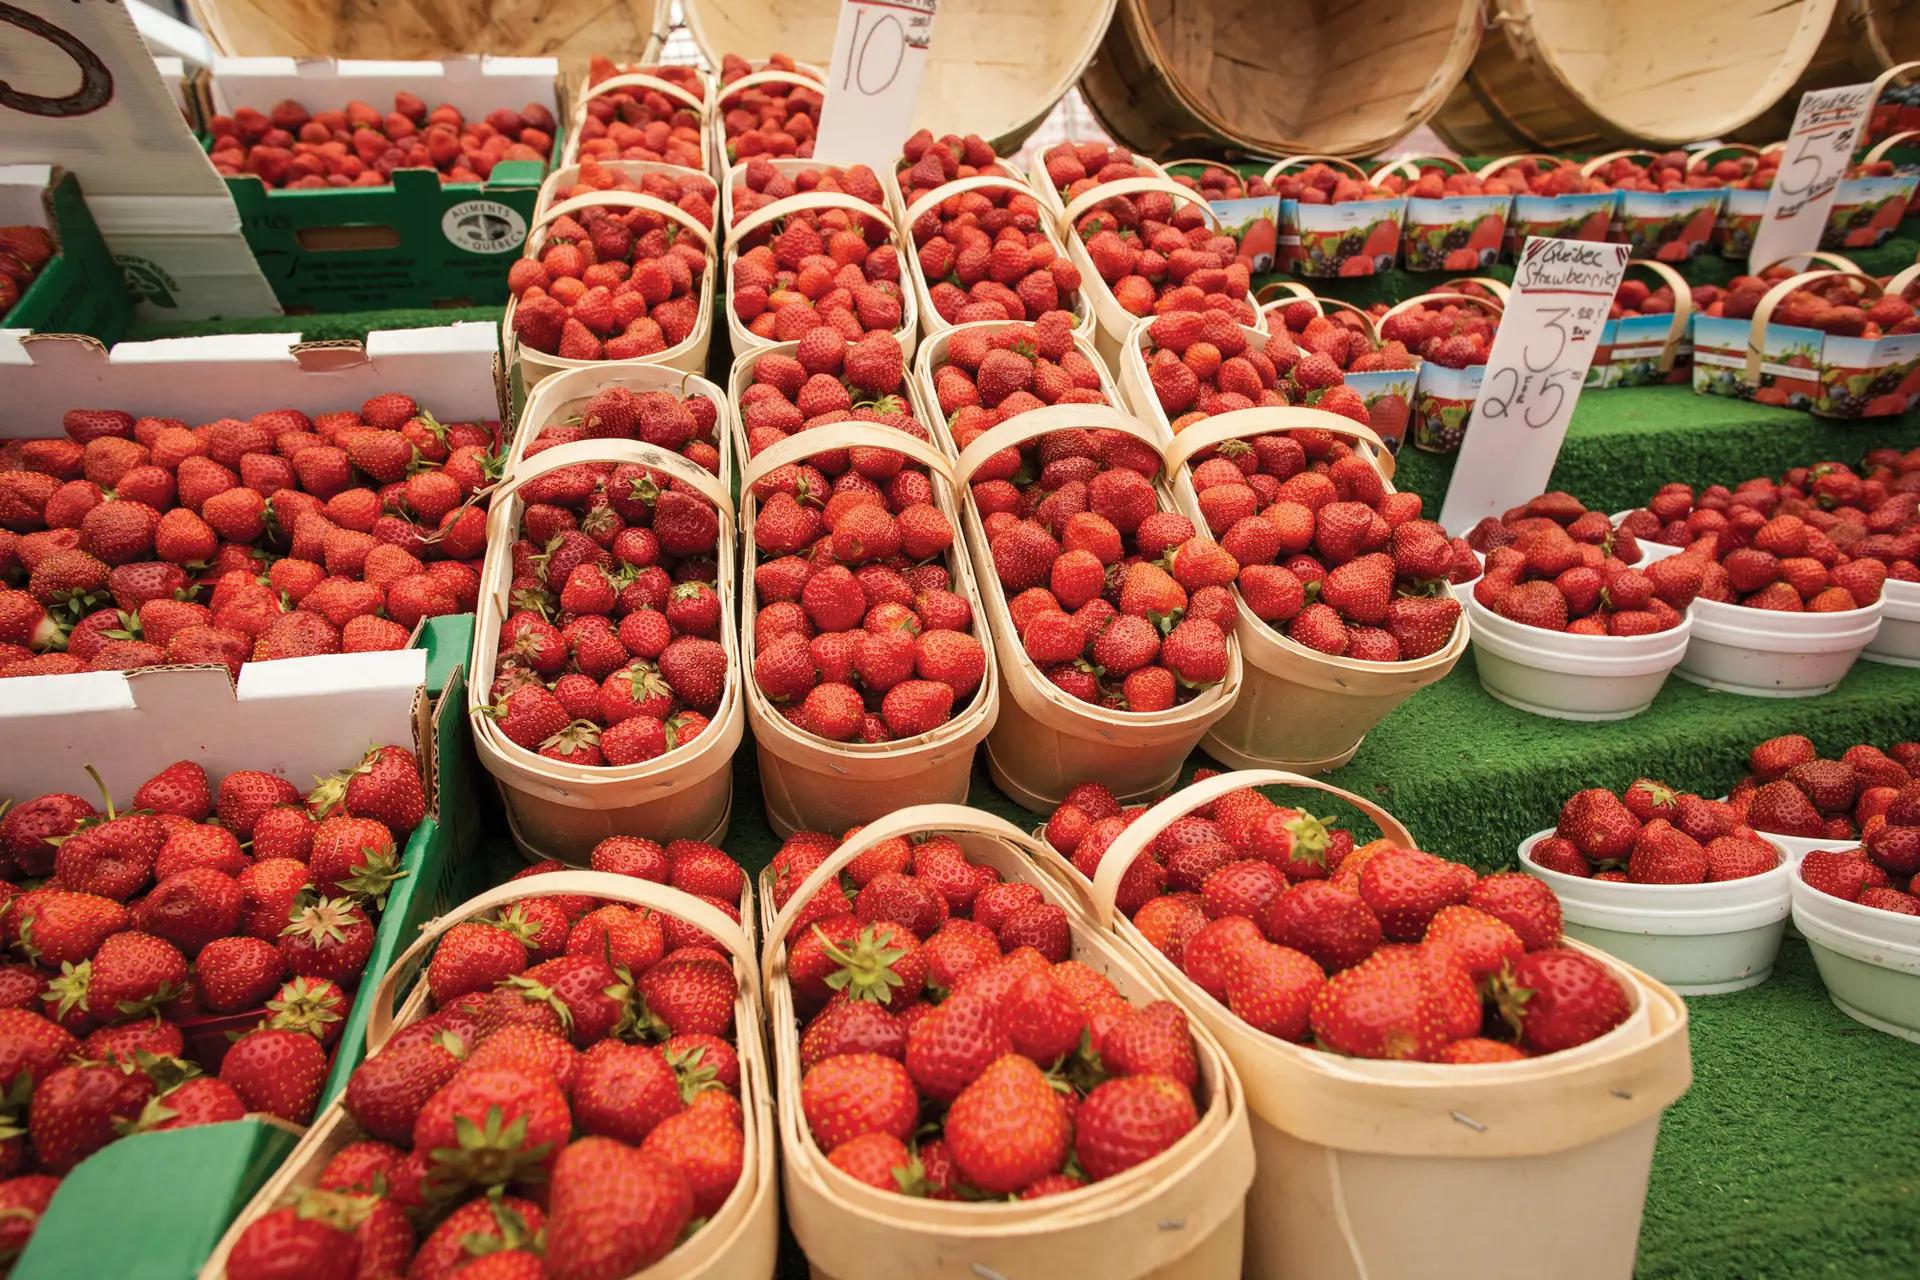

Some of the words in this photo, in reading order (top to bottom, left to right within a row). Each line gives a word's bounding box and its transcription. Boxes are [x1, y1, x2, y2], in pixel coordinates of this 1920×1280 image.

[843, 9, 906, 96] 10
[1780, 132, 1834, 196] 5
[451, 203, 511, 219] ALIMENTS
[1516, 261, 1621, 290] Strawberries
[1481, 366, 1519, 419] 2
